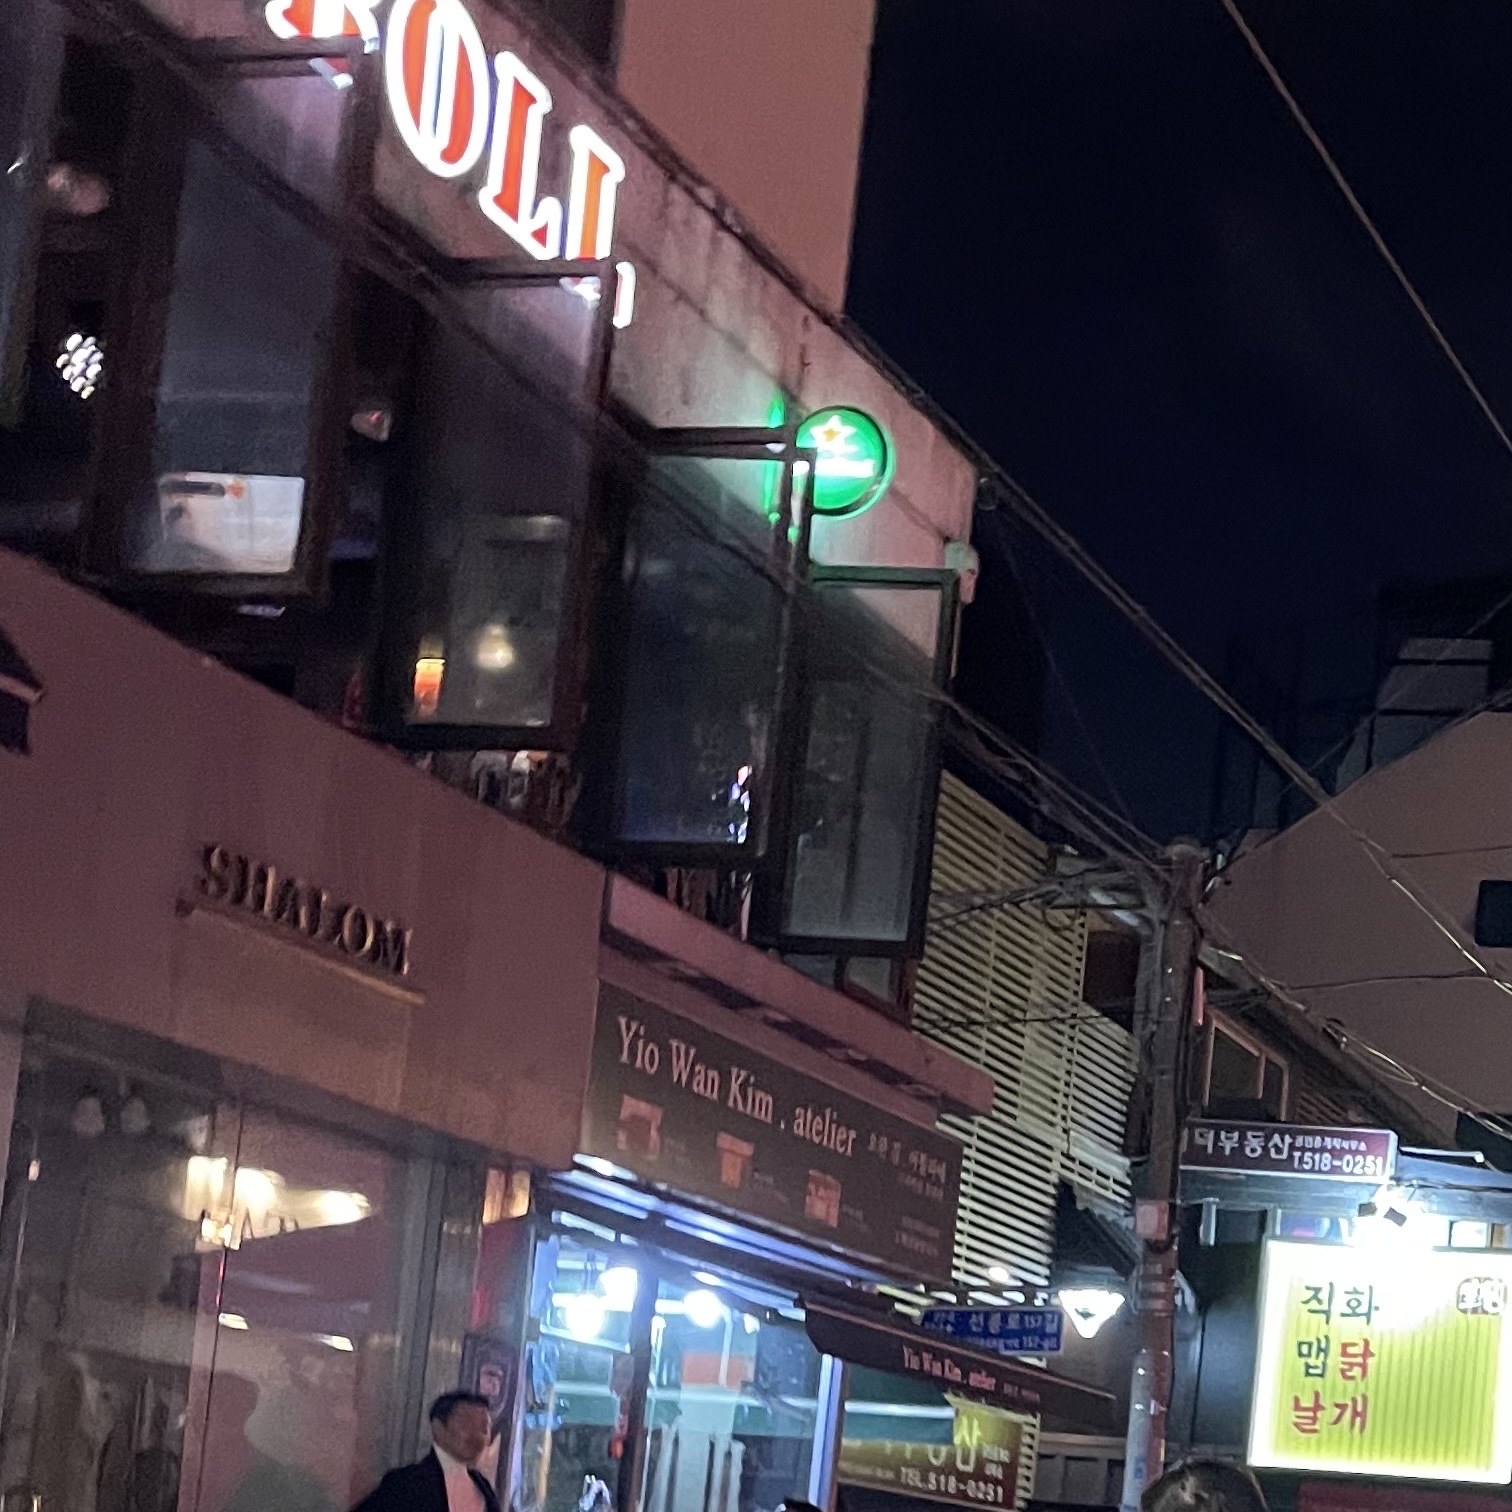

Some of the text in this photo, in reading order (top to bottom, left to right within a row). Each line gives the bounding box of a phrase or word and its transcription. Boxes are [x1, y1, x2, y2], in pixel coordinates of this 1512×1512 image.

[265, 0, 636, 329] OLL
[617, 1015, 857, 1157] Yio Wan Kim atelier
[1301, 1281, 1380, 1326] 직화
[1291, 1389, 1370, 1435] 날개
